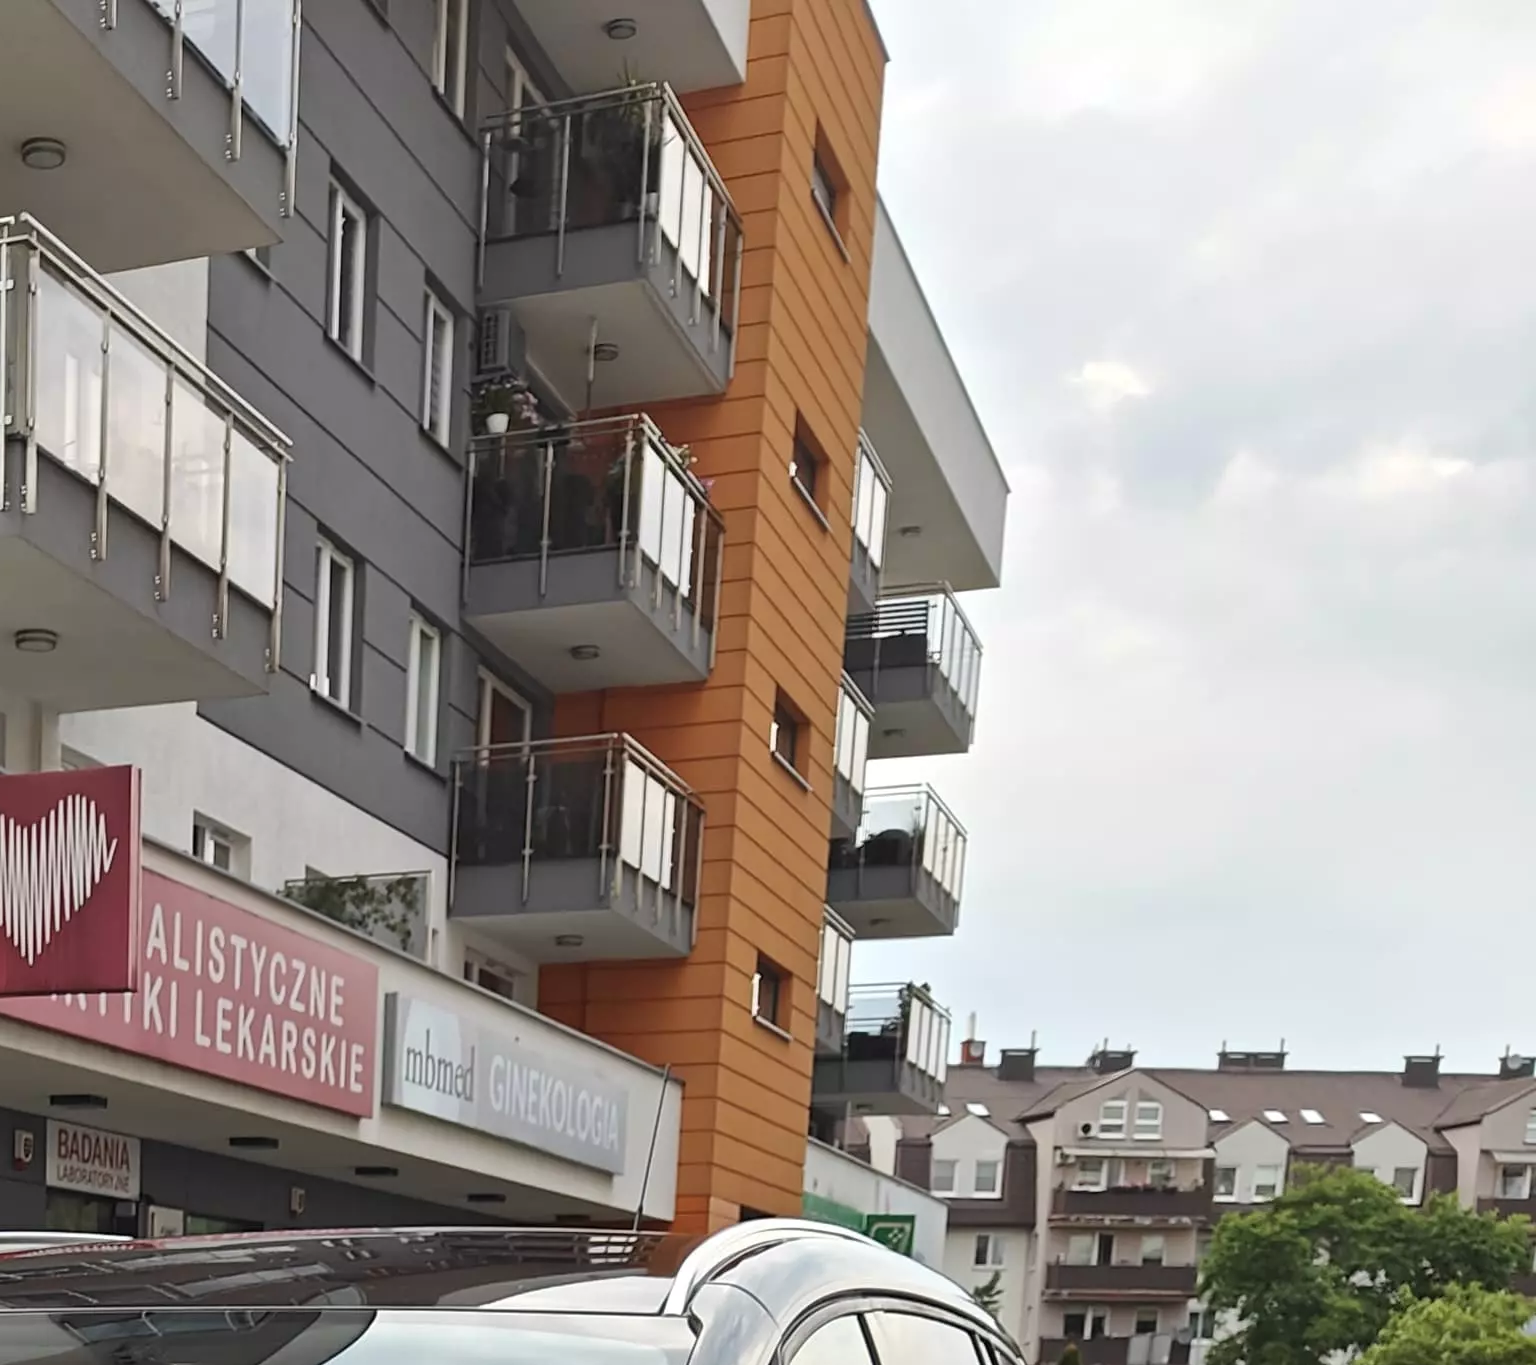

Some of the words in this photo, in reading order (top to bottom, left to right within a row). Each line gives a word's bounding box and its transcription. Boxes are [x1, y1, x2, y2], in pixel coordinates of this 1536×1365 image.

[146, 903, 345, 1027] ALISTYCZNE
[195, 989, 364, 1093] LEKARSKIE
[405, 1028, 475, 1102] mbmed
[57, 1128, 130, 1172] BADANIA
[488, 1055, 619, 1151] GINEKOLOGIA
